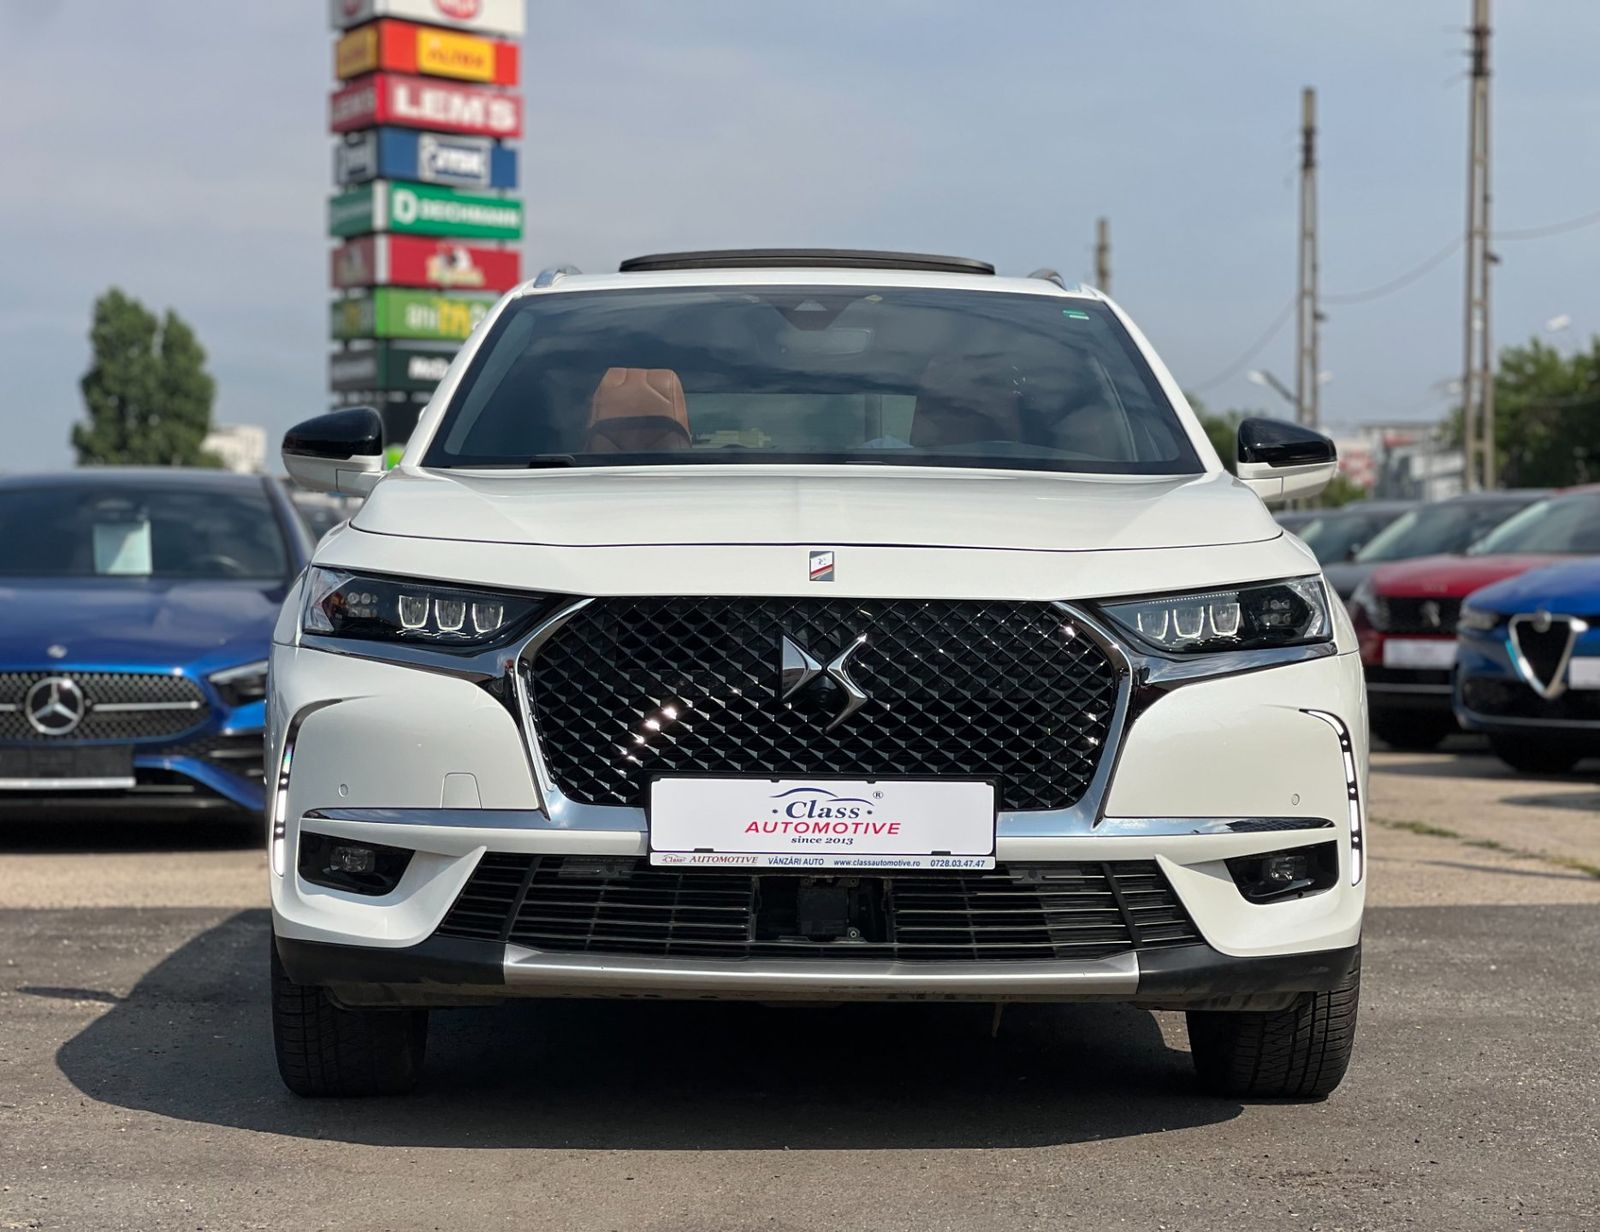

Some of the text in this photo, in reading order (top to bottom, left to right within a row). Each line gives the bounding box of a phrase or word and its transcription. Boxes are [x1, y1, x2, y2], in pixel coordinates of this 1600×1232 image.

[785, 800, 861, 819] Class
[745, 821, 902, 835] AUTOMOTIVE
[791, 836, 854, 845] since 2013
[690, 856, 759, 865] AUTOMOTIVE
[803, 858, 825, 866] AUTO
[833, 858, 921, 868] www.classautomotive.ro
[930, 859, 986, 868] 0728.03.47.47
